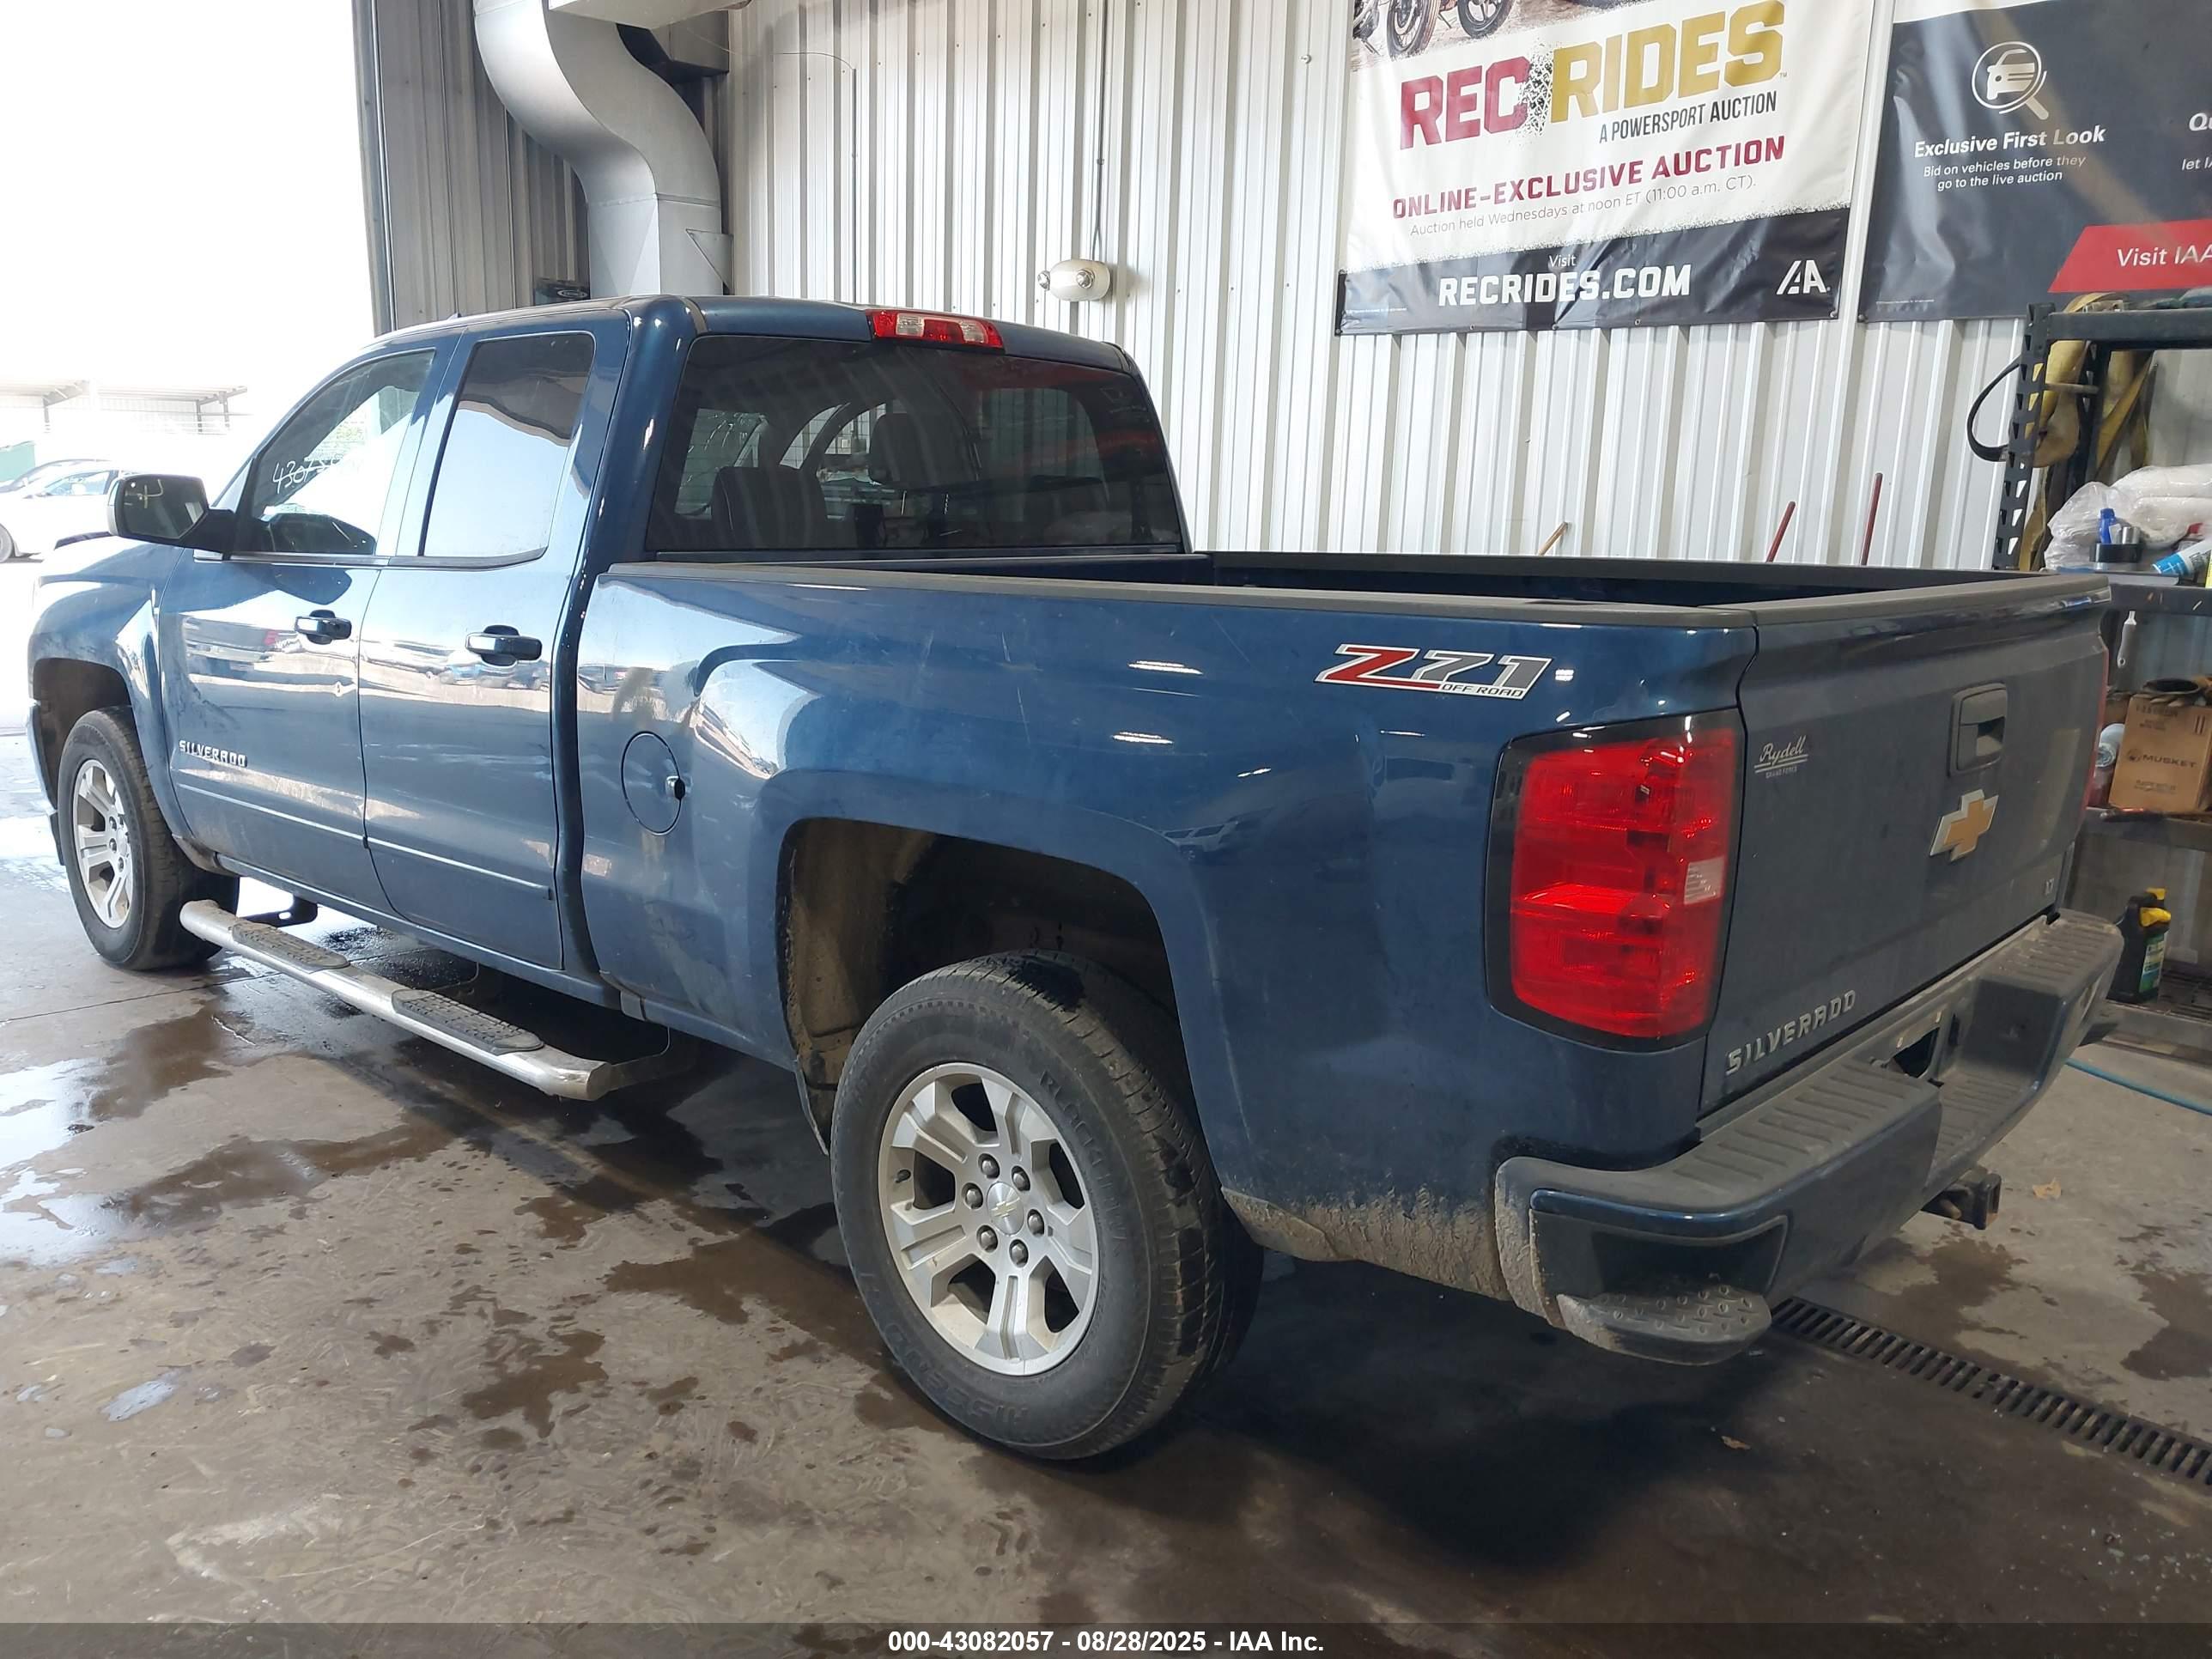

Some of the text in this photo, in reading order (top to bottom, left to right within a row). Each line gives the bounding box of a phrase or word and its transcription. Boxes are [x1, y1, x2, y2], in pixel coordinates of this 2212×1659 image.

[1401, 0, 1784, 149] REC RIDES
[1600, 91, 1778, 143] A POWERSPORT AUCTION
[2188, 112, 2212, 131] Q
[1914, 125, 2106, 158] Exclusive First Look
[1393, 136, 1784, 219] ONLINE-EXCLUSIVE AUCTION
[1923, 155, 2087, 177] Bid on vehicles before they
[2181, 158, 2201, 171] let
[1937, 170, 2063, 191] go to the live auction
[1410, 173, 1756, 236] Auction held Wednesdays at noon ET (11:00 a.m. CT).
[1549, 255, 1577, 267] Visit
[2117, 246, 2167, 267] Visit
[1438, 264, 1692, 307] RECRIDES.COM
[1314, 643, 1553, 690] Z71
[1440, 683, 1524, 698] OFF ROAD
[179, 739, 247, 768] SILVERADO
[1759, 734, 1807, 766] Rydell
[2142, 754, 2197, 769] MUSKET
[1724, 989, 1857, 1076] SILVERADO
